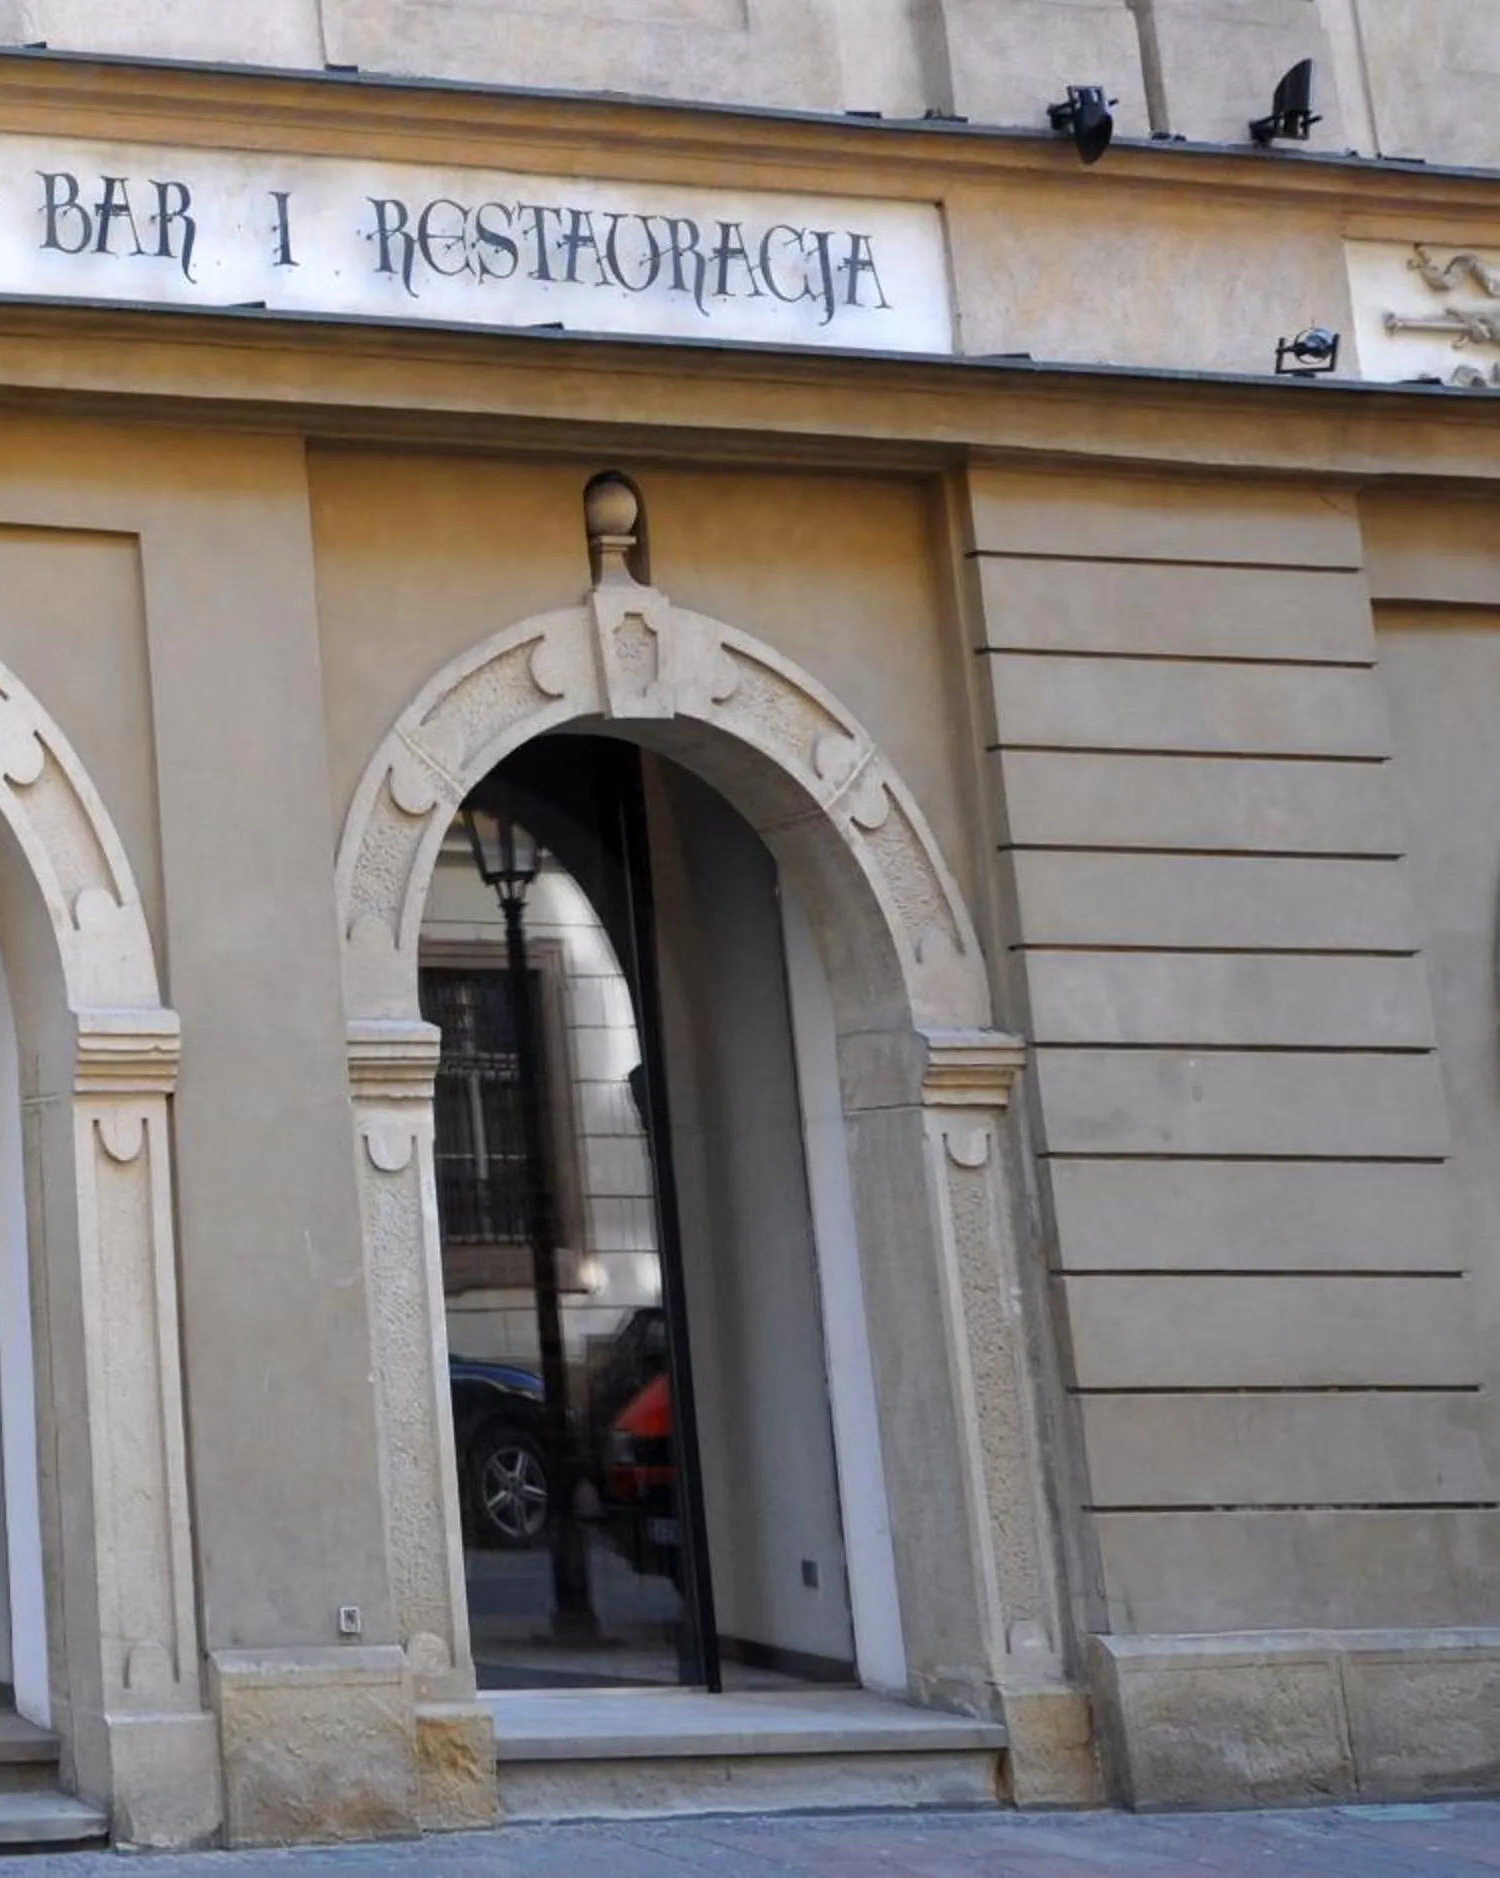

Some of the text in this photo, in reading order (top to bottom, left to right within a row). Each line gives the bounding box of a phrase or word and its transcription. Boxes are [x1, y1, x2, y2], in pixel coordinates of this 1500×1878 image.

[36, 171, 197, 284] BAR
[269, 191, 300, 267] I
[366, 196, 891, 326] RESTAURACJA
